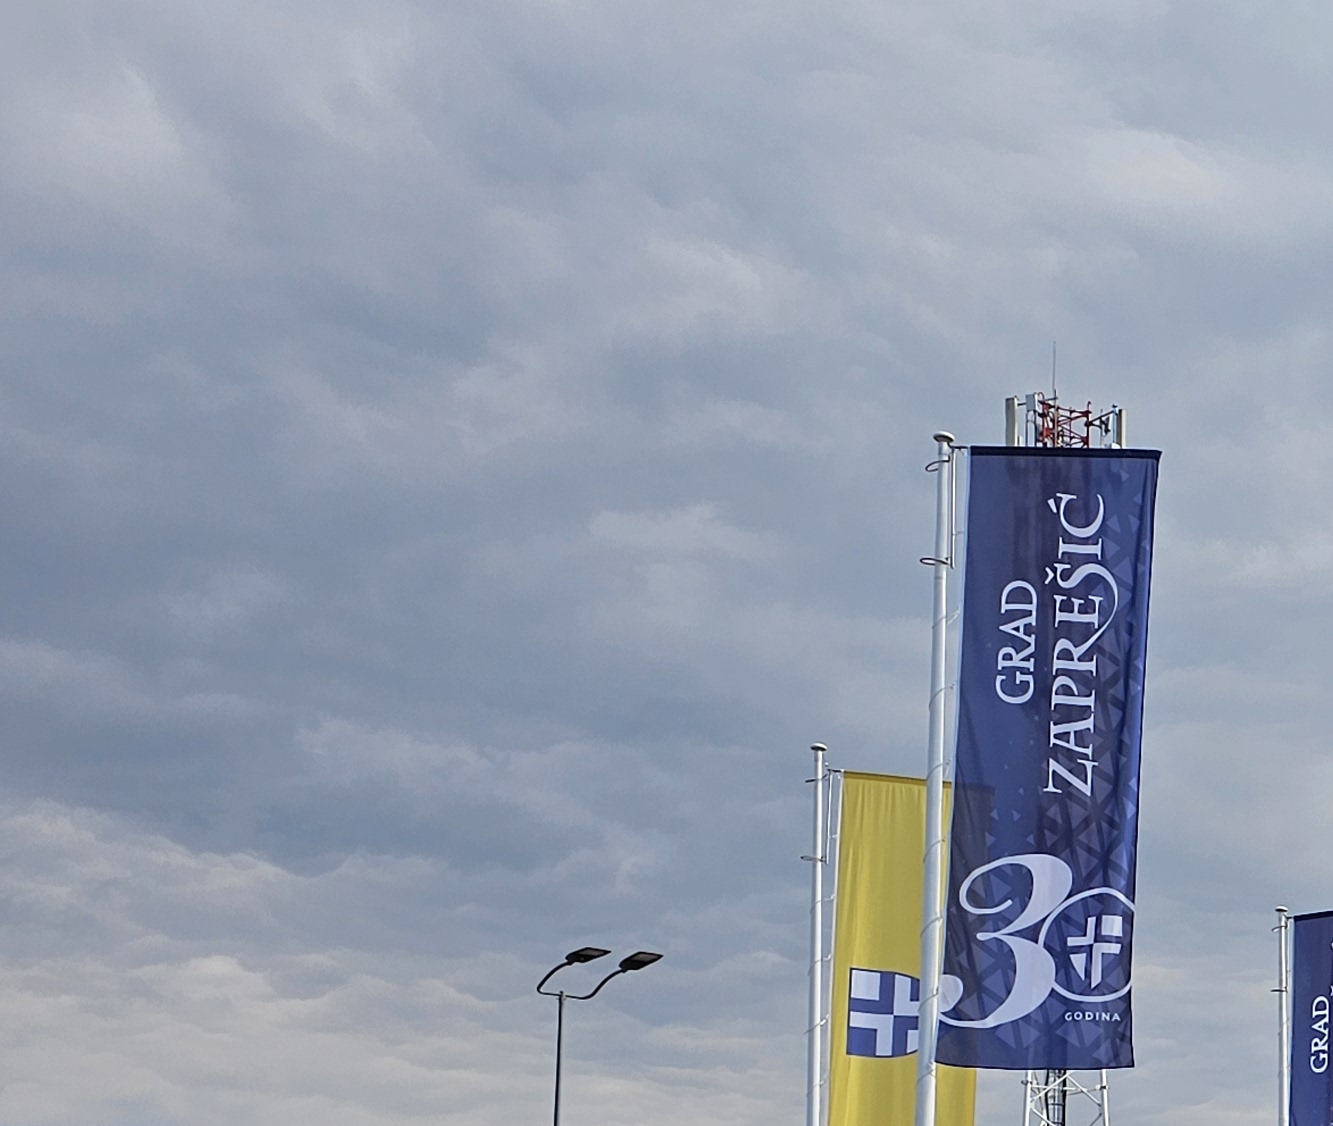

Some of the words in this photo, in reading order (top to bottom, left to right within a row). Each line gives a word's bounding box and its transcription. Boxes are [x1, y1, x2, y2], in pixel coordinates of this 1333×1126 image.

[995, 579, 1039, 705] GRAD
[1043, 492, 1119, 797] ZAPREŠIĆ
[1063, 1010, 1122, 1023] GODINA
[1310, 994, 1330, 1074] GRAD
